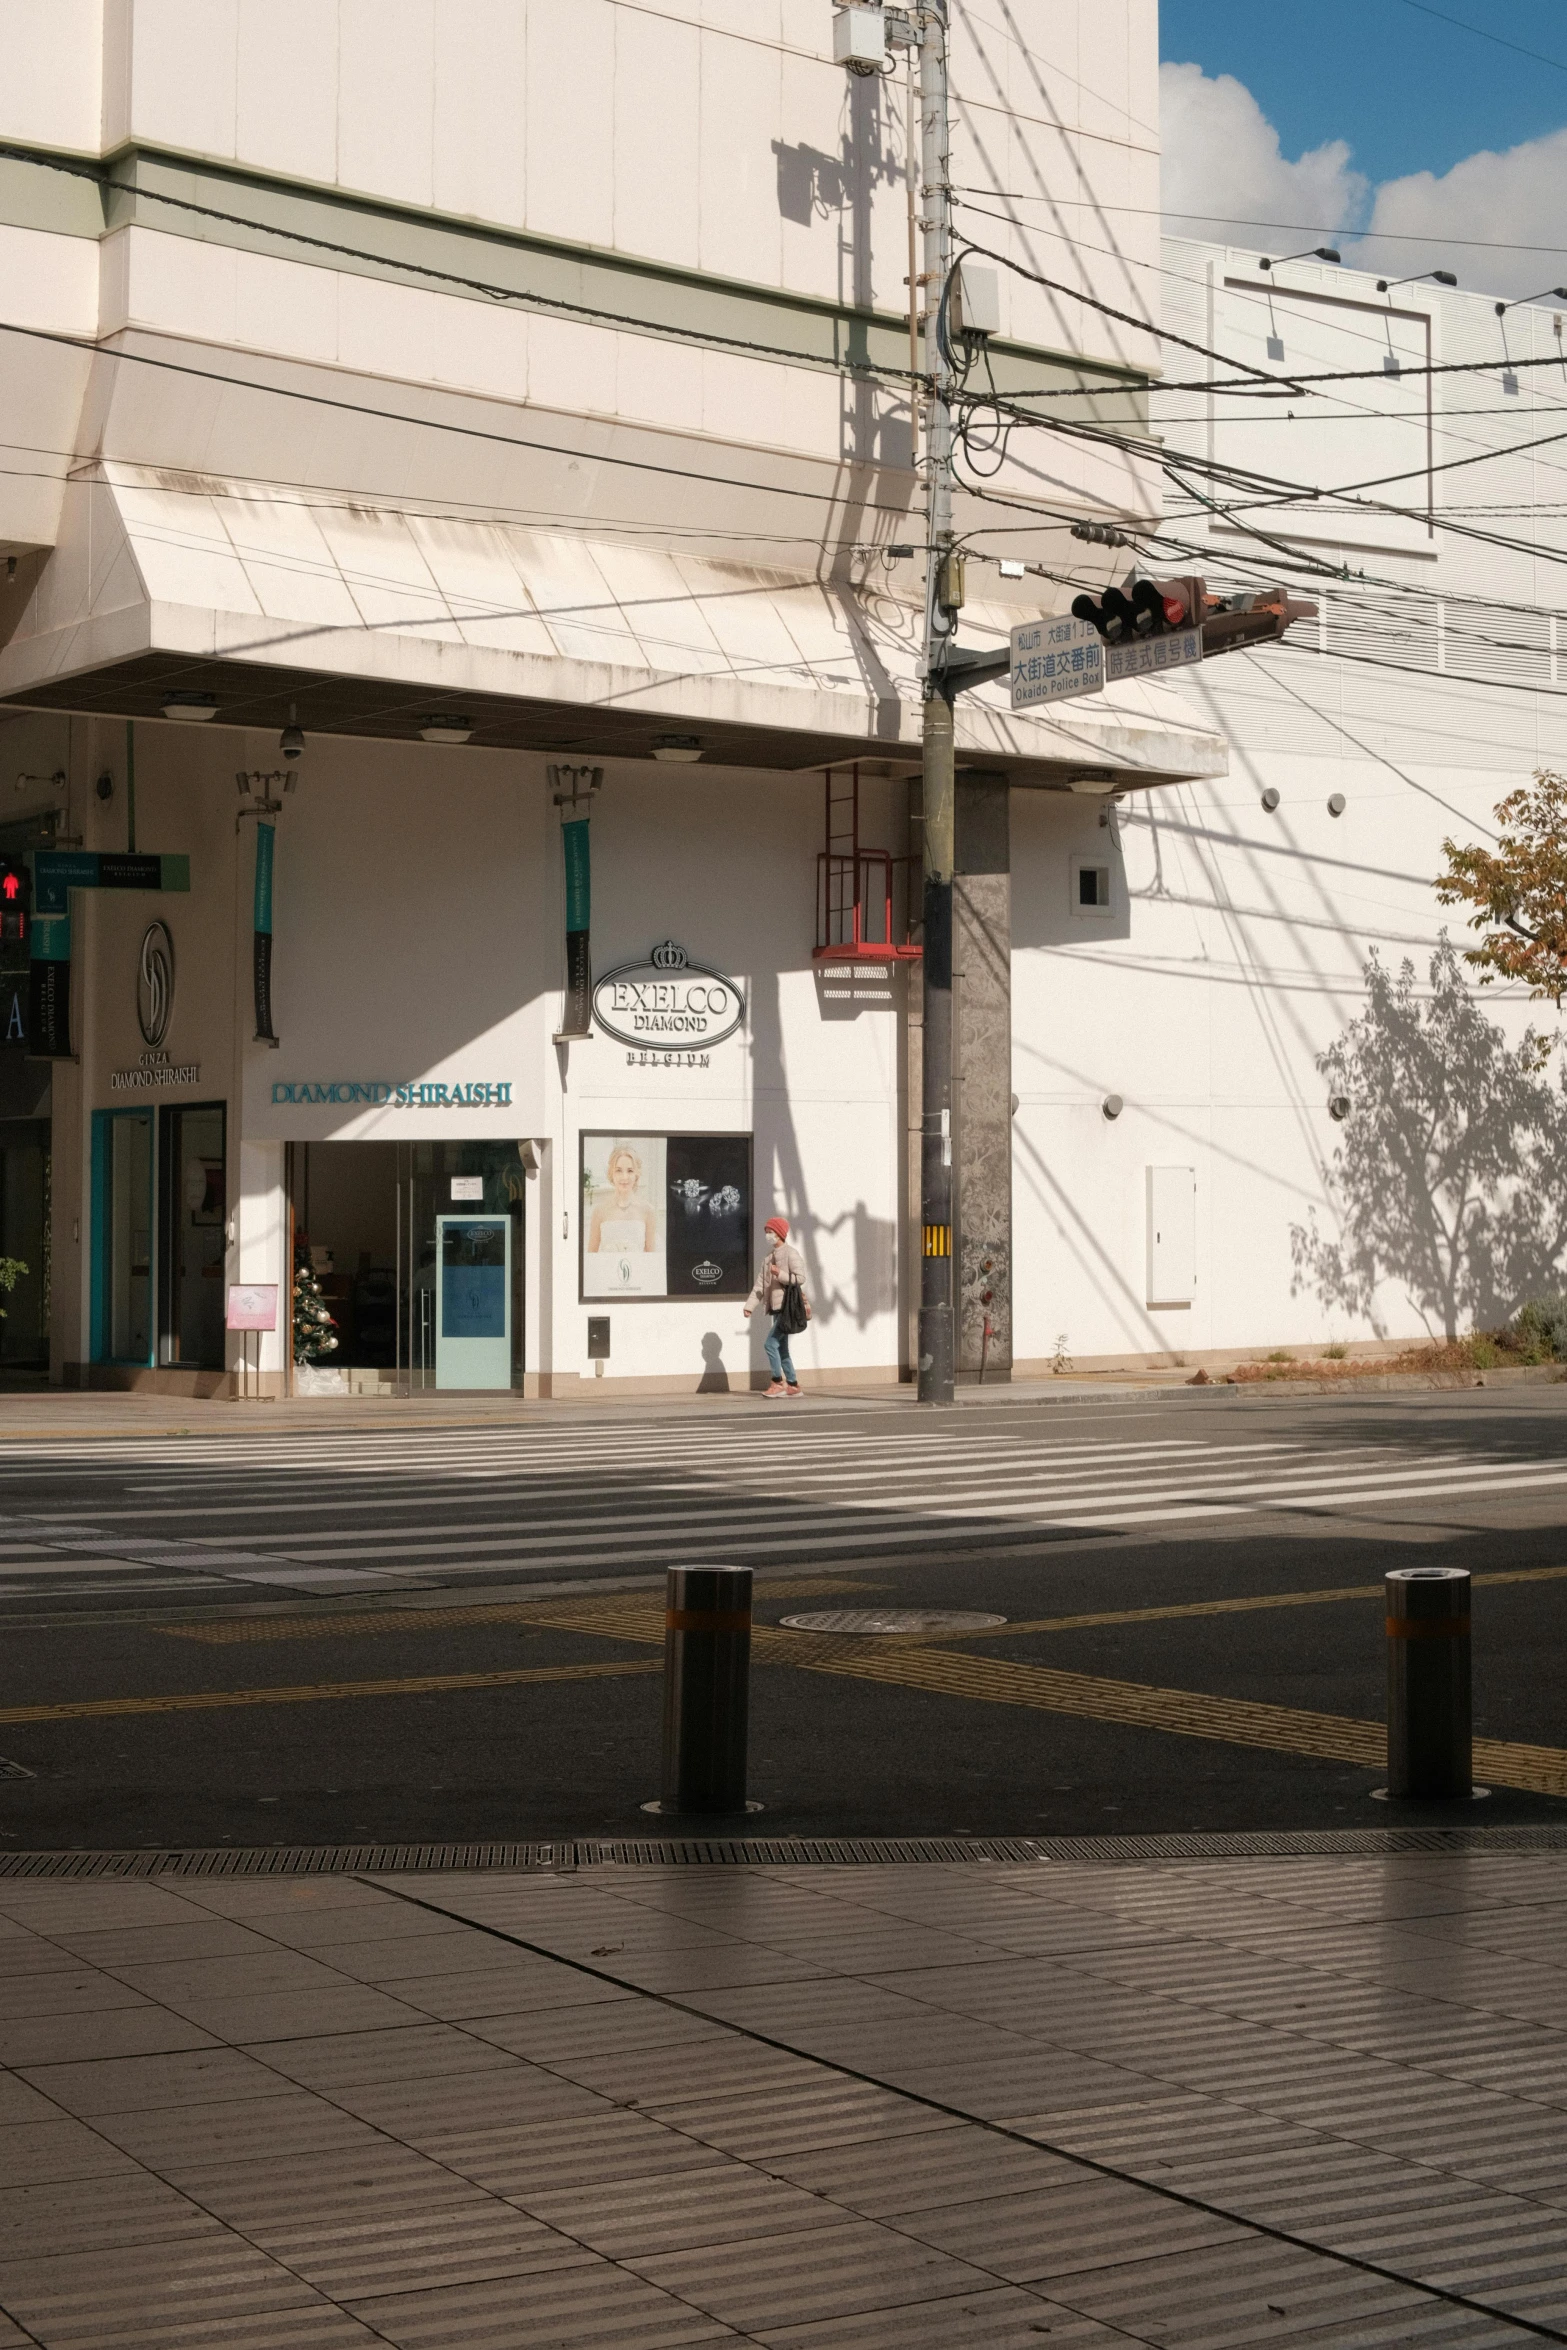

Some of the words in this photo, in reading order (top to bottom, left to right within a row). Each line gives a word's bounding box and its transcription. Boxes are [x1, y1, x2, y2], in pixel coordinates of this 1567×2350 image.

[1017, 630, 1042, 652] 松山市
[1013, 643, 1100, 685] 大街道交番前
[1110, 634, 1197, 676] 時差式信号機
[1015, 684, 1048, 702] Okaido
[1050, 674, 1080, 694] Police
[1082, 671, 1100, 686] Box
[47, 966, 55, 1003] EXELCO
[611, 981, 728, 1015] EXELCO
[47, 1004, 56, 1051] DIAMOND
[634, 1015, 708, 1033] DIAMOND
[138, 1052, 168, 1065] GINZA
[626, 1052, 710, 1066] BELGIUM
[111, 1070, 153, 1089] DIAMOND
[154, 1066, 198, 1086] SHIRAISHI
[271, 1082, 392, 1104] DIAMOND
[394, 1082, 513, 1105] SHIRAISHI
